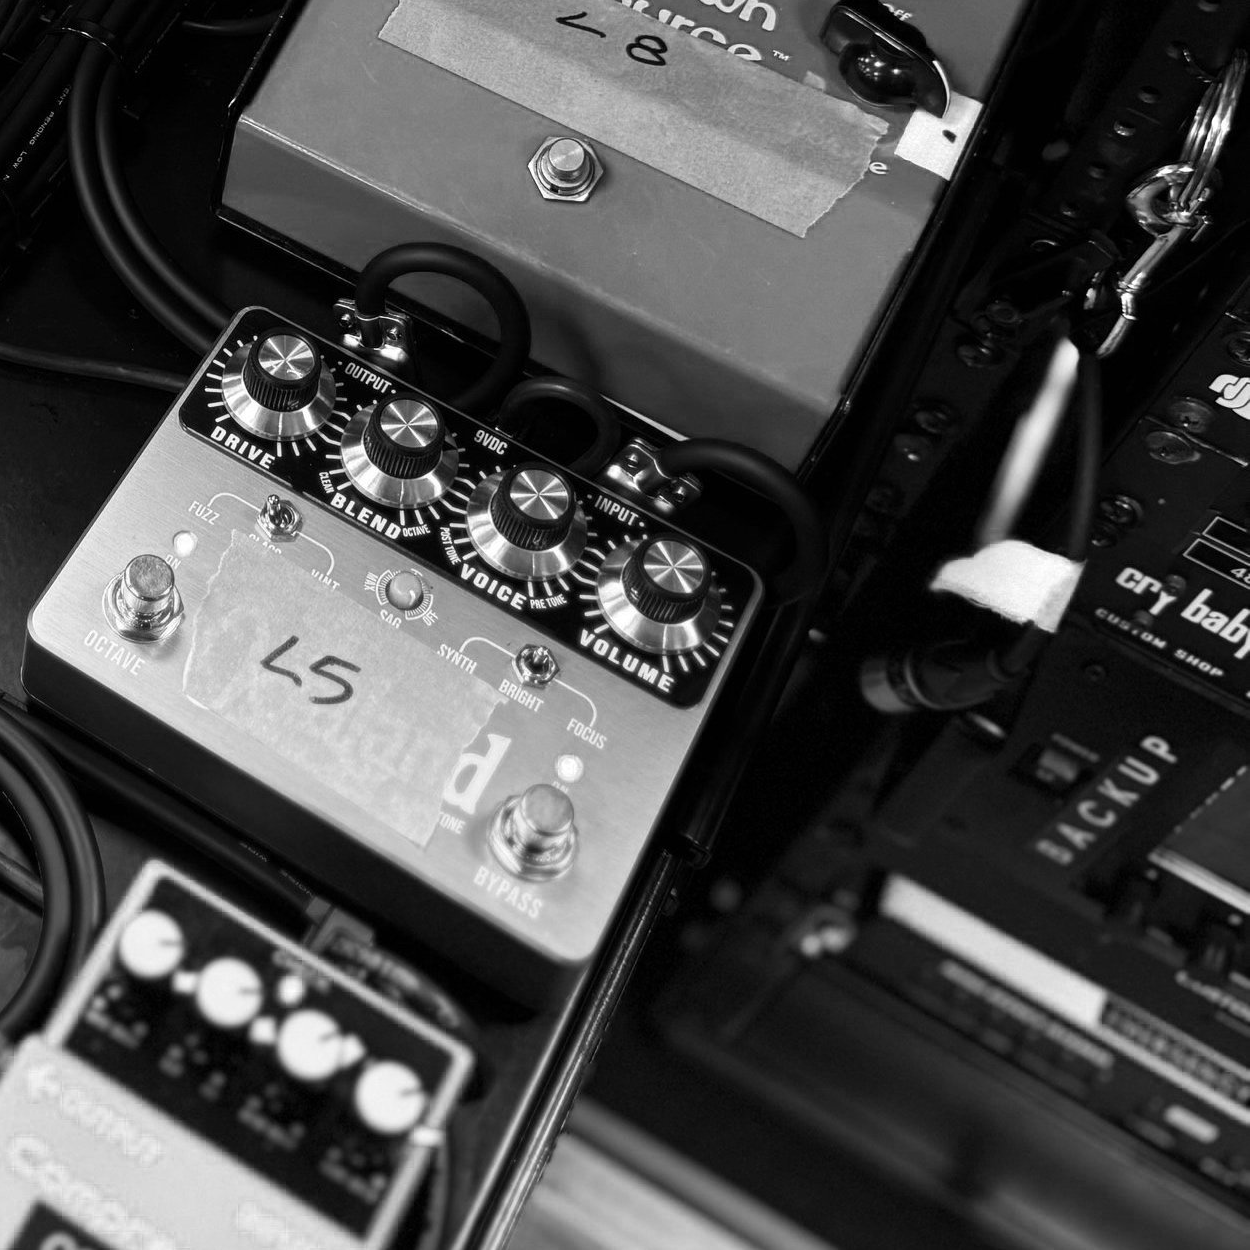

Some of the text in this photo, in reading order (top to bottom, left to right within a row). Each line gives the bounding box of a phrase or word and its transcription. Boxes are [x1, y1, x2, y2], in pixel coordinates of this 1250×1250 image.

[13, 150, 28, 169] LOW
[344, 361, 392, 393] OUTPUT
[211, 426, 276, 469] DRIVE
[473, 429, 508, 455] 9VDC
[319, 471, 335, 494] CLEAN
[188, 500, 220, 525] FUZZ
[330, 492, 401, 540] BLEND
[595, 495, 638, 527] INPUT
[403, 524, 431, 537] OCTAVE
[440, 526, 461, 565] POST TONE
[165, 553, 182, 570] ON
[364, 571, 378, 592] MAX
[459, 563, 527, 610] VOICE
[1116, 566, 1177, 617] cry
[530, 593, 567, 609] PRE TONE
[379, 609, 402, 629] SAG
[422, 610, 439, 626] OFF
[84, 629, 146, 676] OCTAVE
[1095, 607, 1225, 678] CUSTOM SHOP
[260, 635, 361, 705] L5
[437, 643, 478, 675] SYNTH
[578, 629, 675, 694] VOLUME
[497, 678, 545, 713] BRIGHT
[566, 717, 608, 750] FOCUS
[1035, 735, 1178, 865] BACKUP
[472, 865, 544, 920] BYPASS
